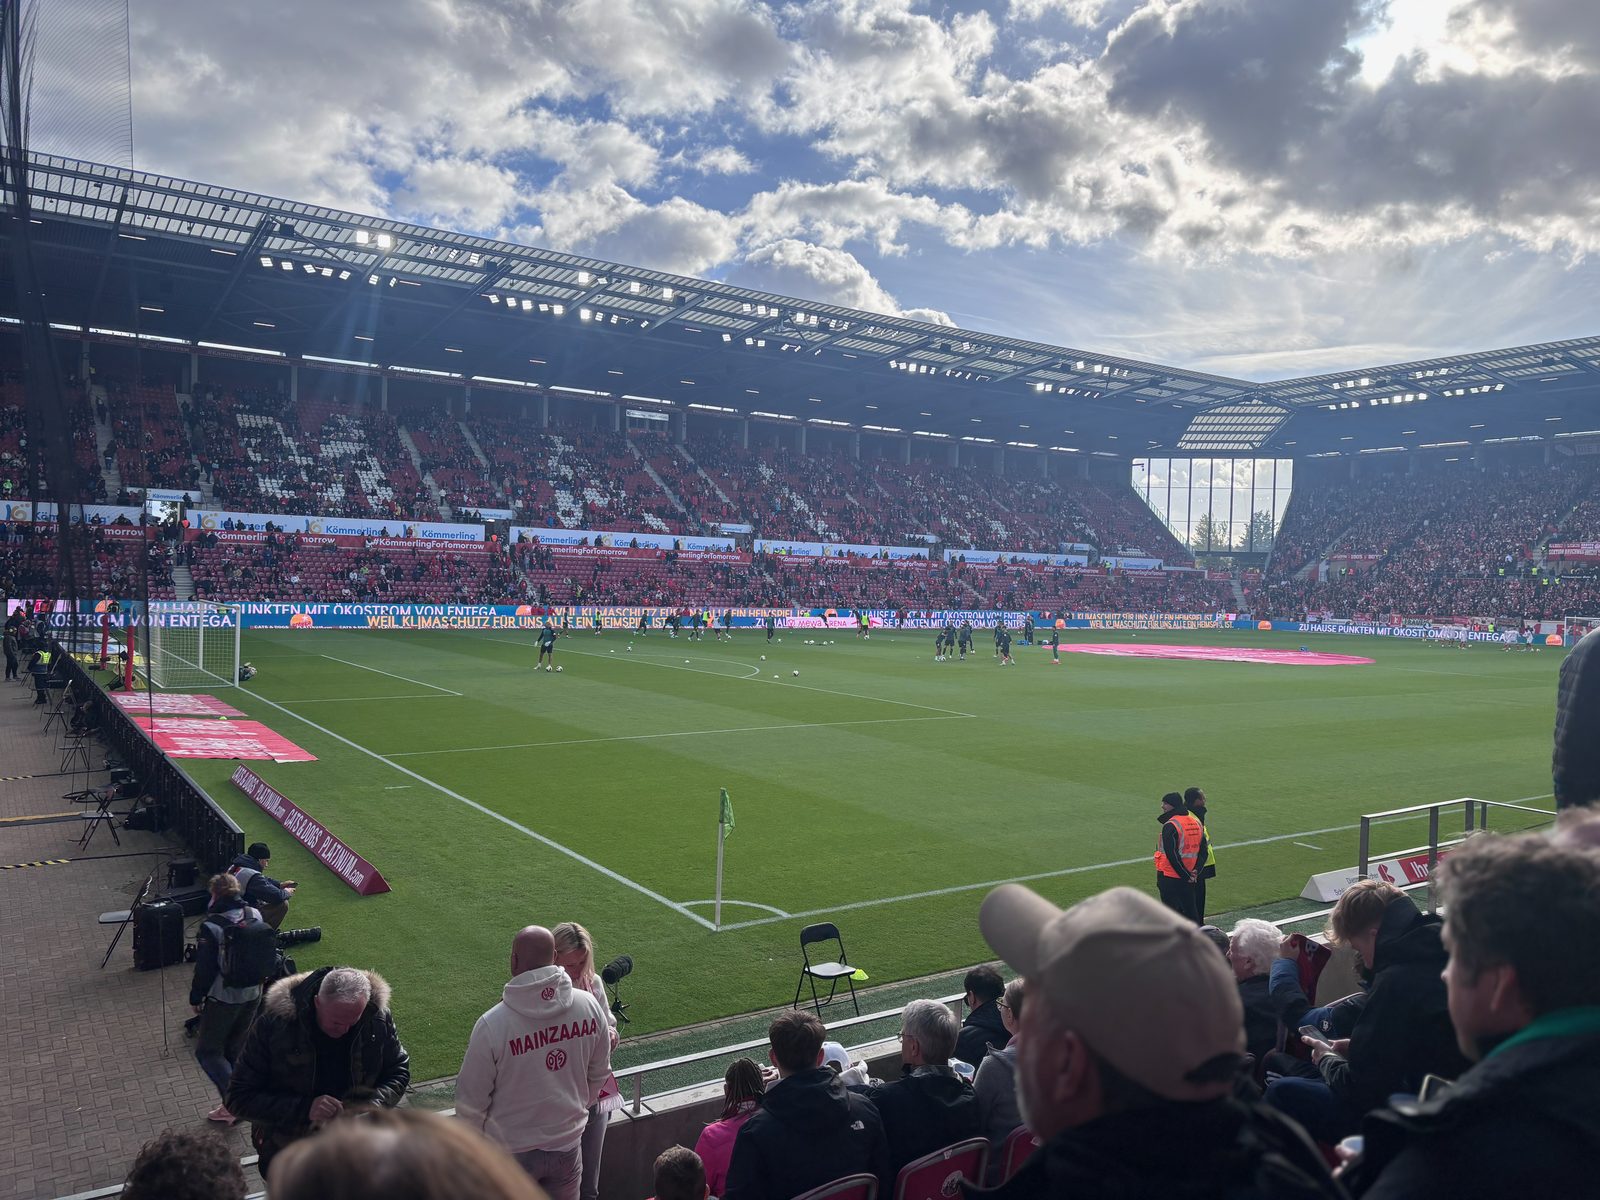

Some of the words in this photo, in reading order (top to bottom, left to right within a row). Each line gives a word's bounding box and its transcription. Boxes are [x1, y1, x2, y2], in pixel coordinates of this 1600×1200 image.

[422, 529, 476, 541] Kömmerling
[540, 535, 581, 547] ömmerling
[614, 539, 659, 549] Kömerling
[366, 615, 399, 627] WEIL
[402, 616, 490, 627] KLIMASCHUTZ
[493, 614, 516, 627] FÜR
[518, 616, 543, 627] UNS
[575, 616, 593, 627] EIN
[1299, 623, 1309, 632] ZU
[1310, 624, 1337, 633] HAUSE
[1338, 625, 1375, 636] PUNKTEN
[1376, 626, 1391, 636] MIT
[318, 835, 364, 887] PLATINUM.com
[509, 1017, 597, 1056] MAINZAAAA
